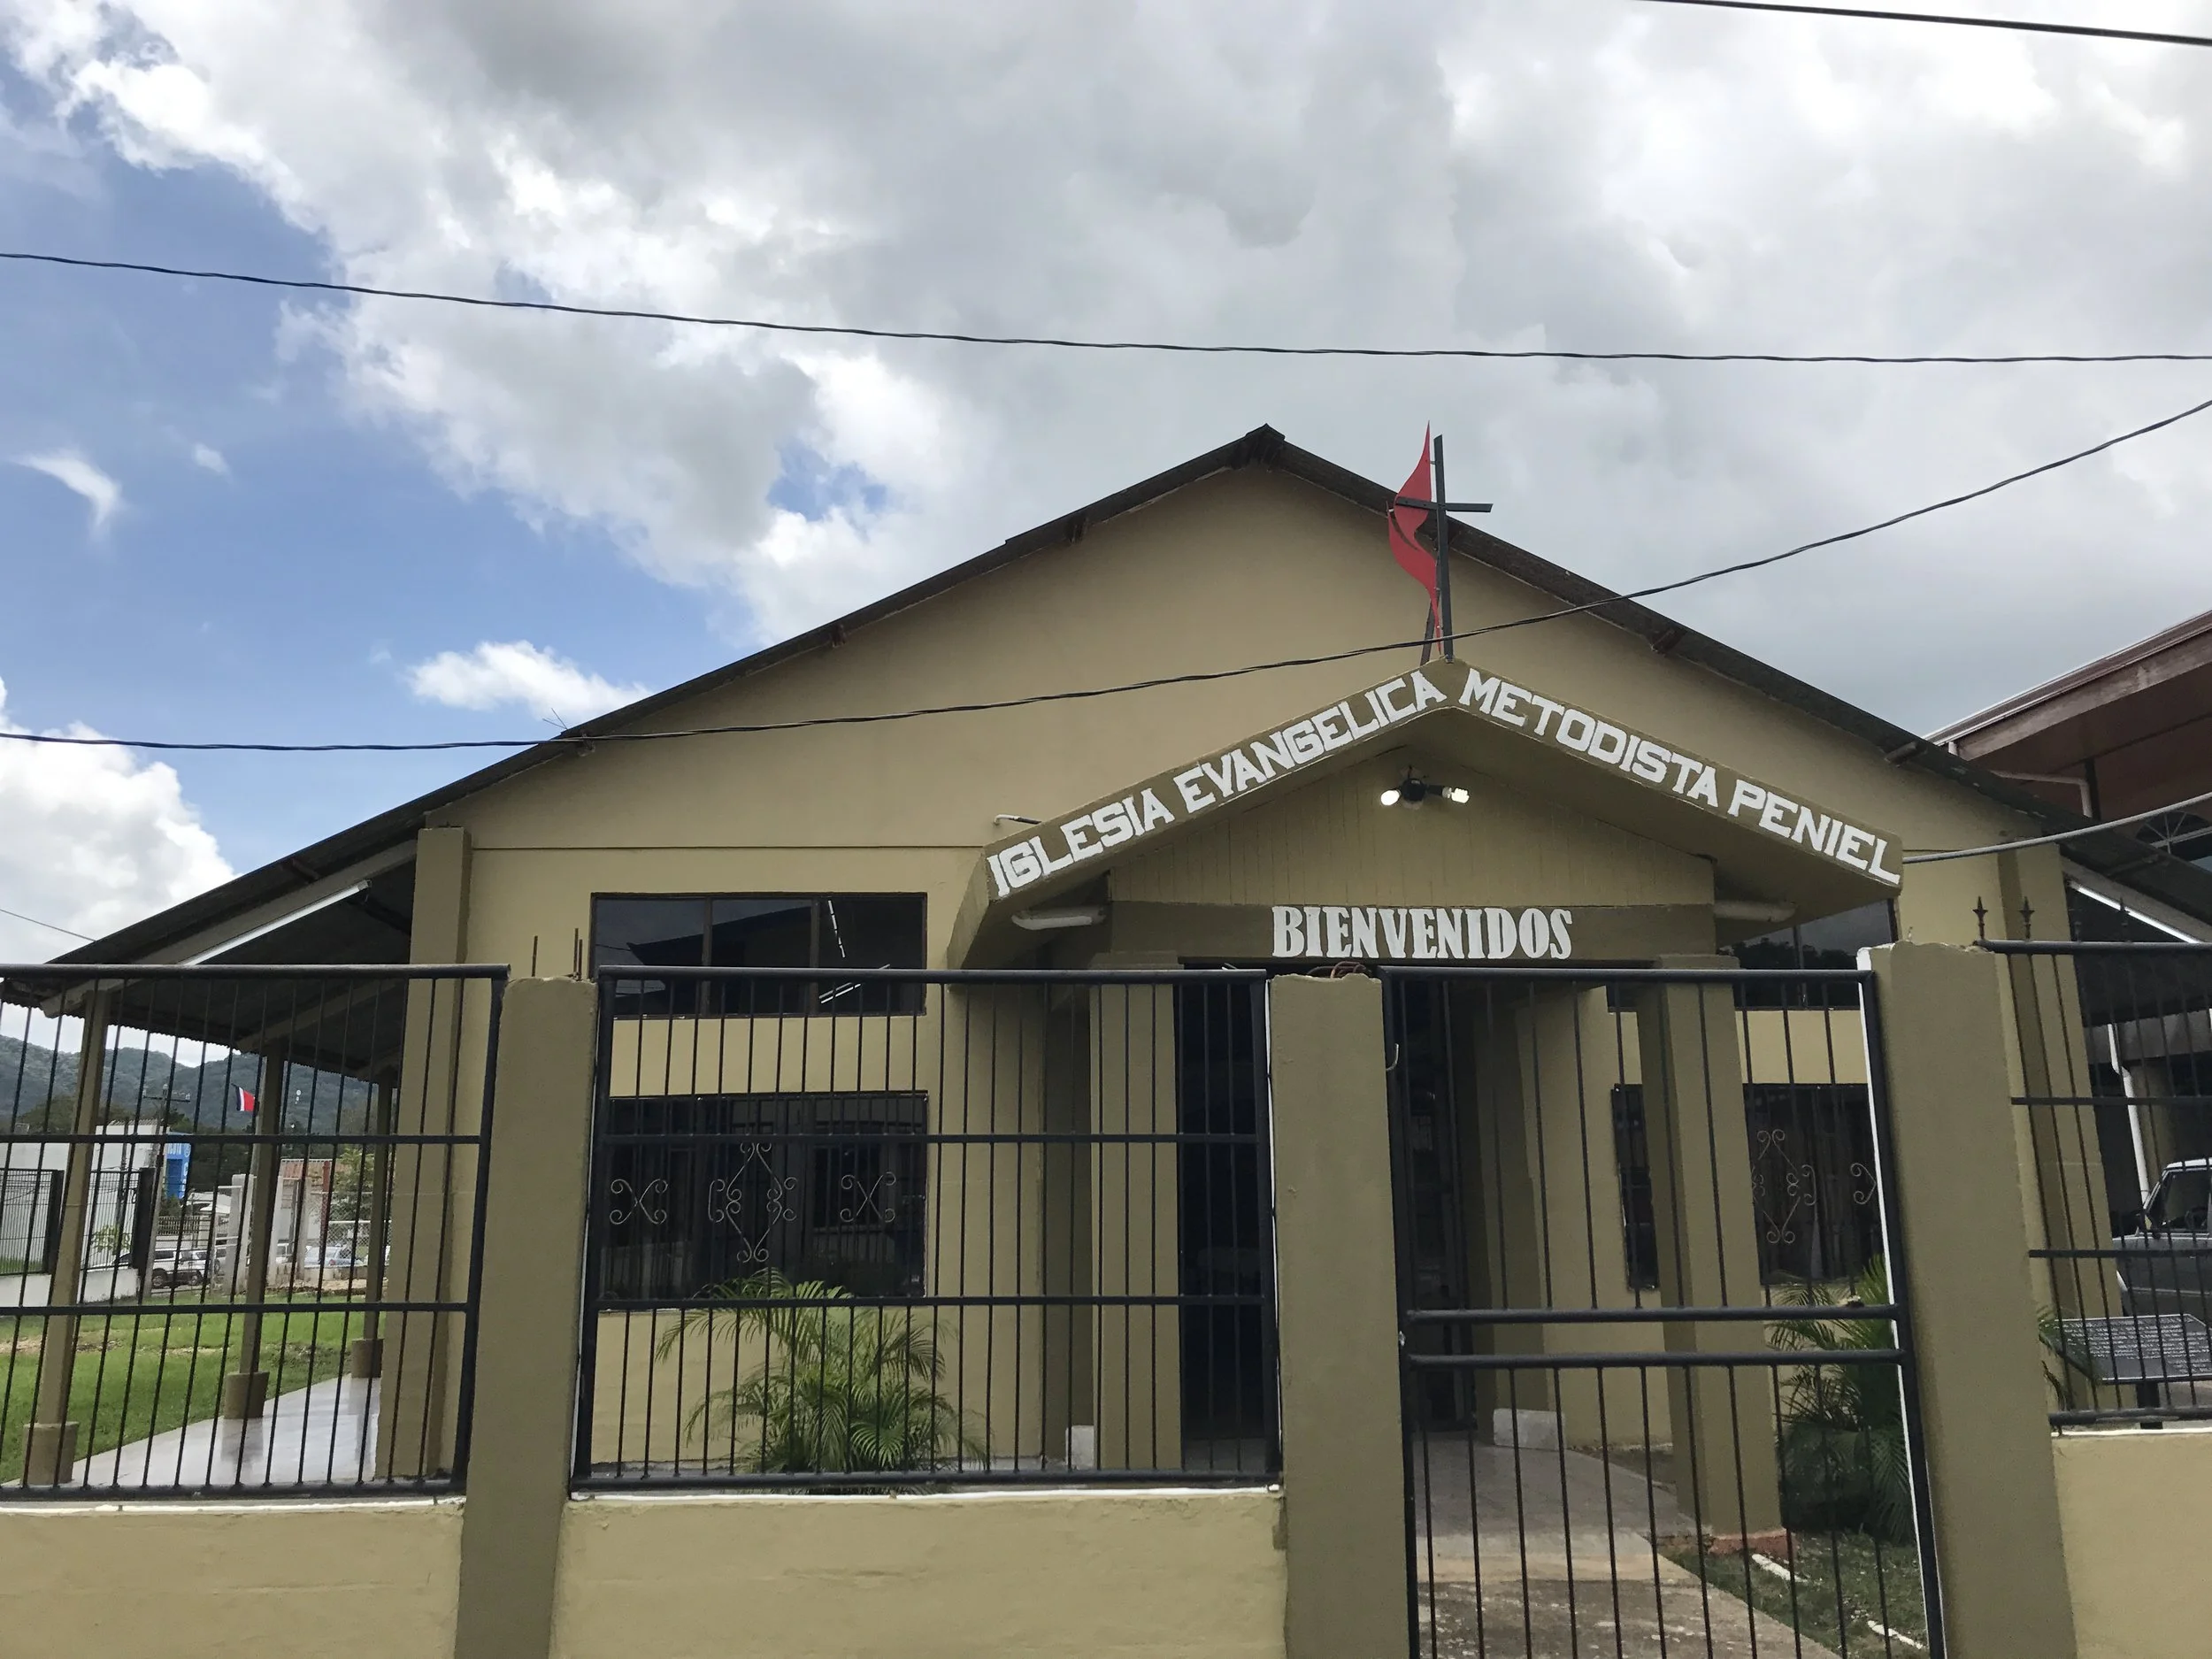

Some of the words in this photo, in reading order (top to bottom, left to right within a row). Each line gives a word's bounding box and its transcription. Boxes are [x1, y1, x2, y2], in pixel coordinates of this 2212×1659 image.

[987, 787, 1175, 898] IGLESIA
[1172, 670, 1448, 813] EVANGELICA
[1458, 667, 1718, 808] METODISTA
[1727, 779, 1901, 885] PENIEL
[1271, 906, 1572, 959] BIENVENIDOS
